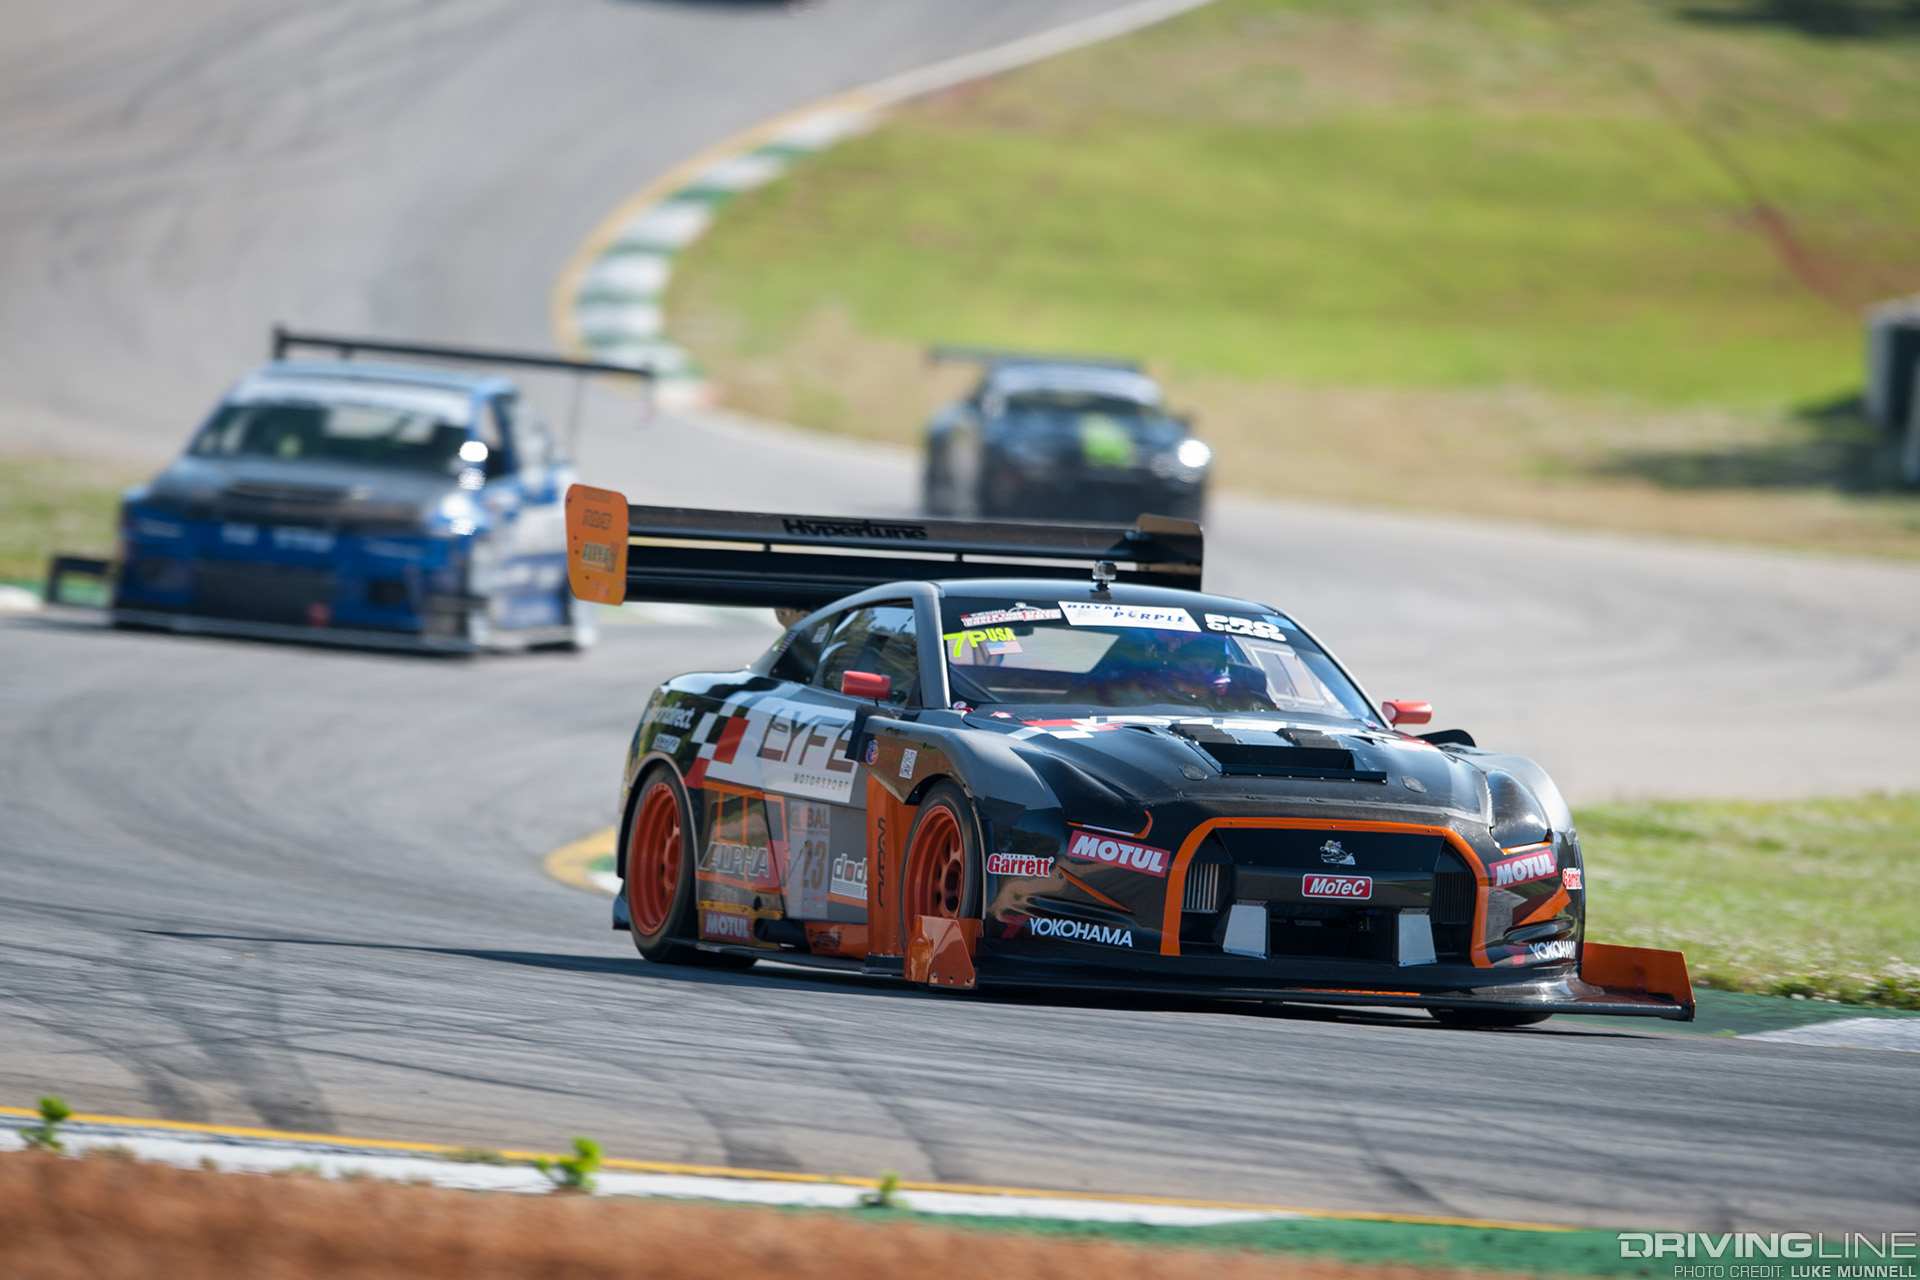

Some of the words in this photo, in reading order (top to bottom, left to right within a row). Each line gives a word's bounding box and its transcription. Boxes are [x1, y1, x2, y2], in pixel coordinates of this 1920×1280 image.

[1113, 611, 1186, 623] PURPLE
[1204, 613, 1280, 634] PRO
[984, 627, 1017, 642] USA
[793, 773, 849, 791] MOTORSPORT
[698, 840, 770, 878] ALPHA
[987, 854, 1050, 877] Garrett
[1071, 835, 1163, 873] MOTUL
[1495, 853, 1555, 886] MOTUL
[1309, 878, 1366, 896] MoTeC
[705, 914, 751, 939] MOTUL
[1029, 917, 1133, 948] YOKOHAMA
